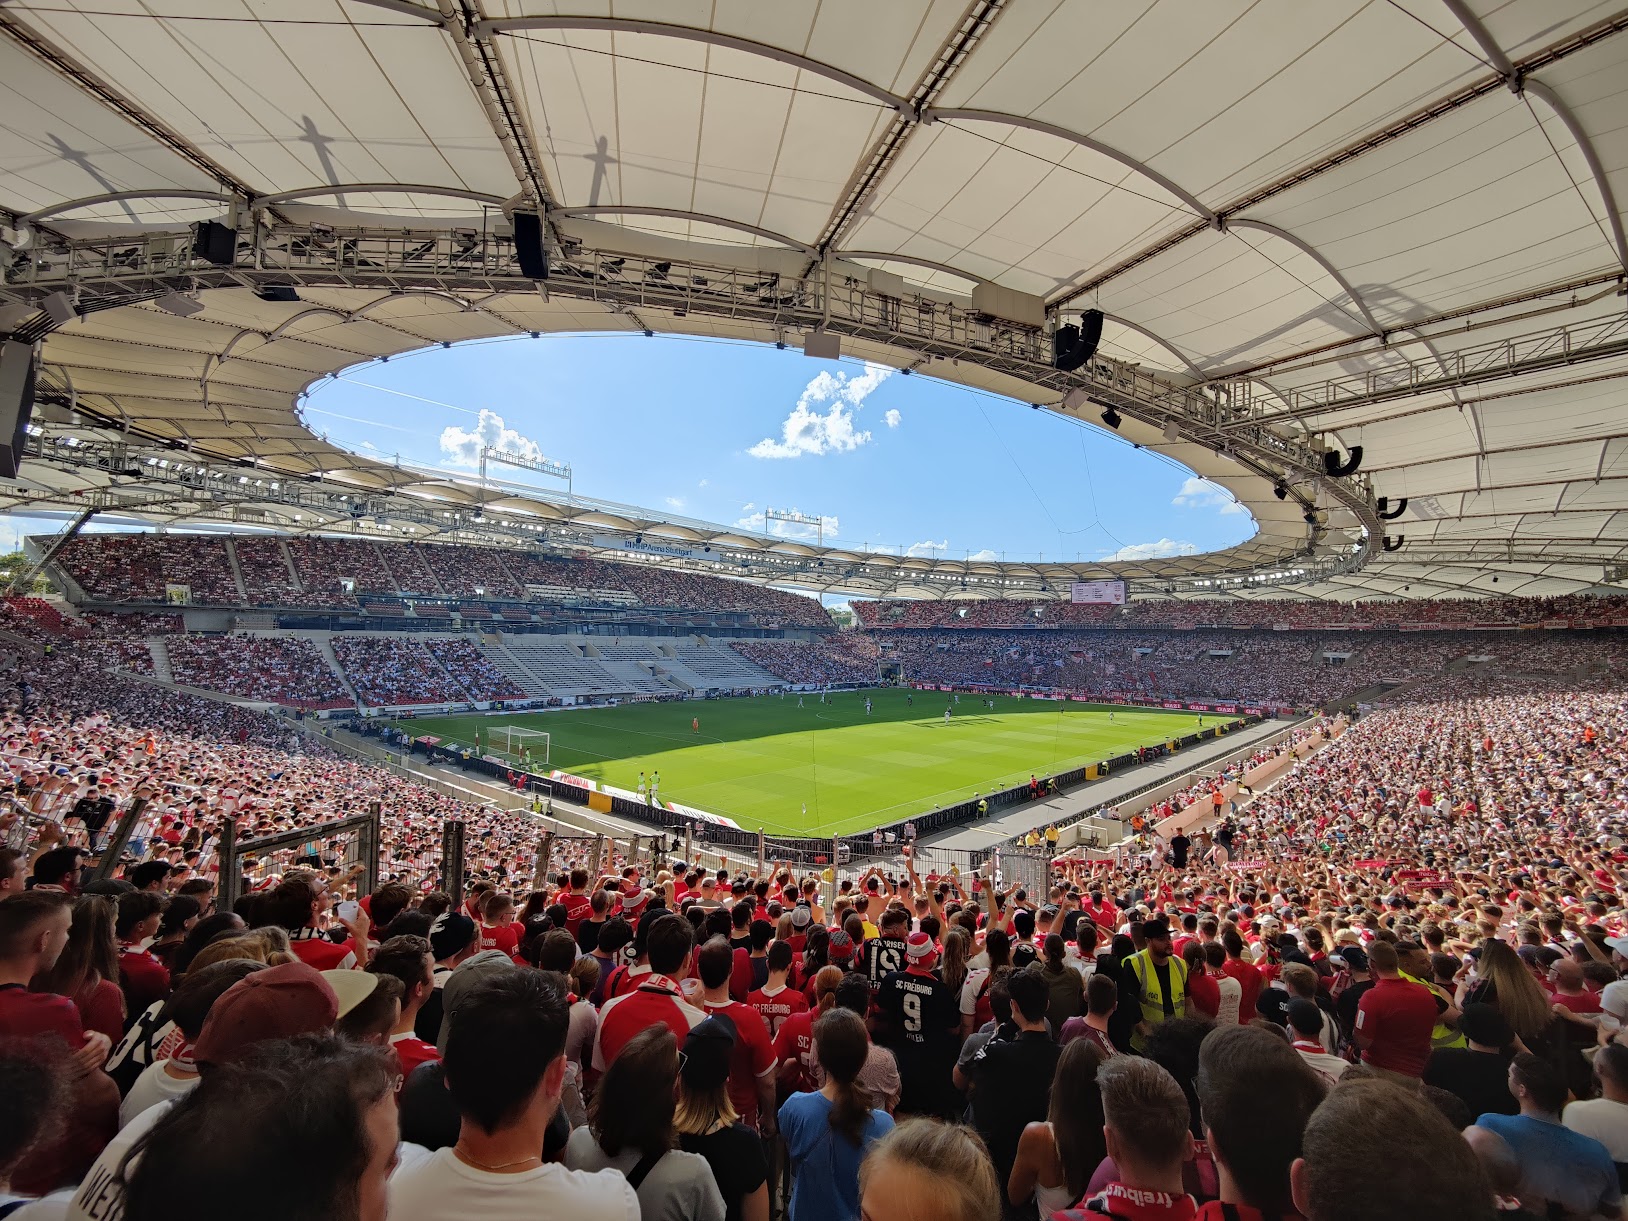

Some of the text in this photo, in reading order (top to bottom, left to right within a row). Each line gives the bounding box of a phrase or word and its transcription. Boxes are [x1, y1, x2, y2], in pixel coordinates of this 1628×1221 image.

[632, 542, 693, 556] MHP Arena Stuttgart
[895, 980, 933, 996] SC FREIBURG
[760, 1003, 791, 1014] FREIBURG
[903, 993, 922, 1032] 9
[1279, 1002, 1289, 1012] SC
[797, 1035, 810, 1049] SC
